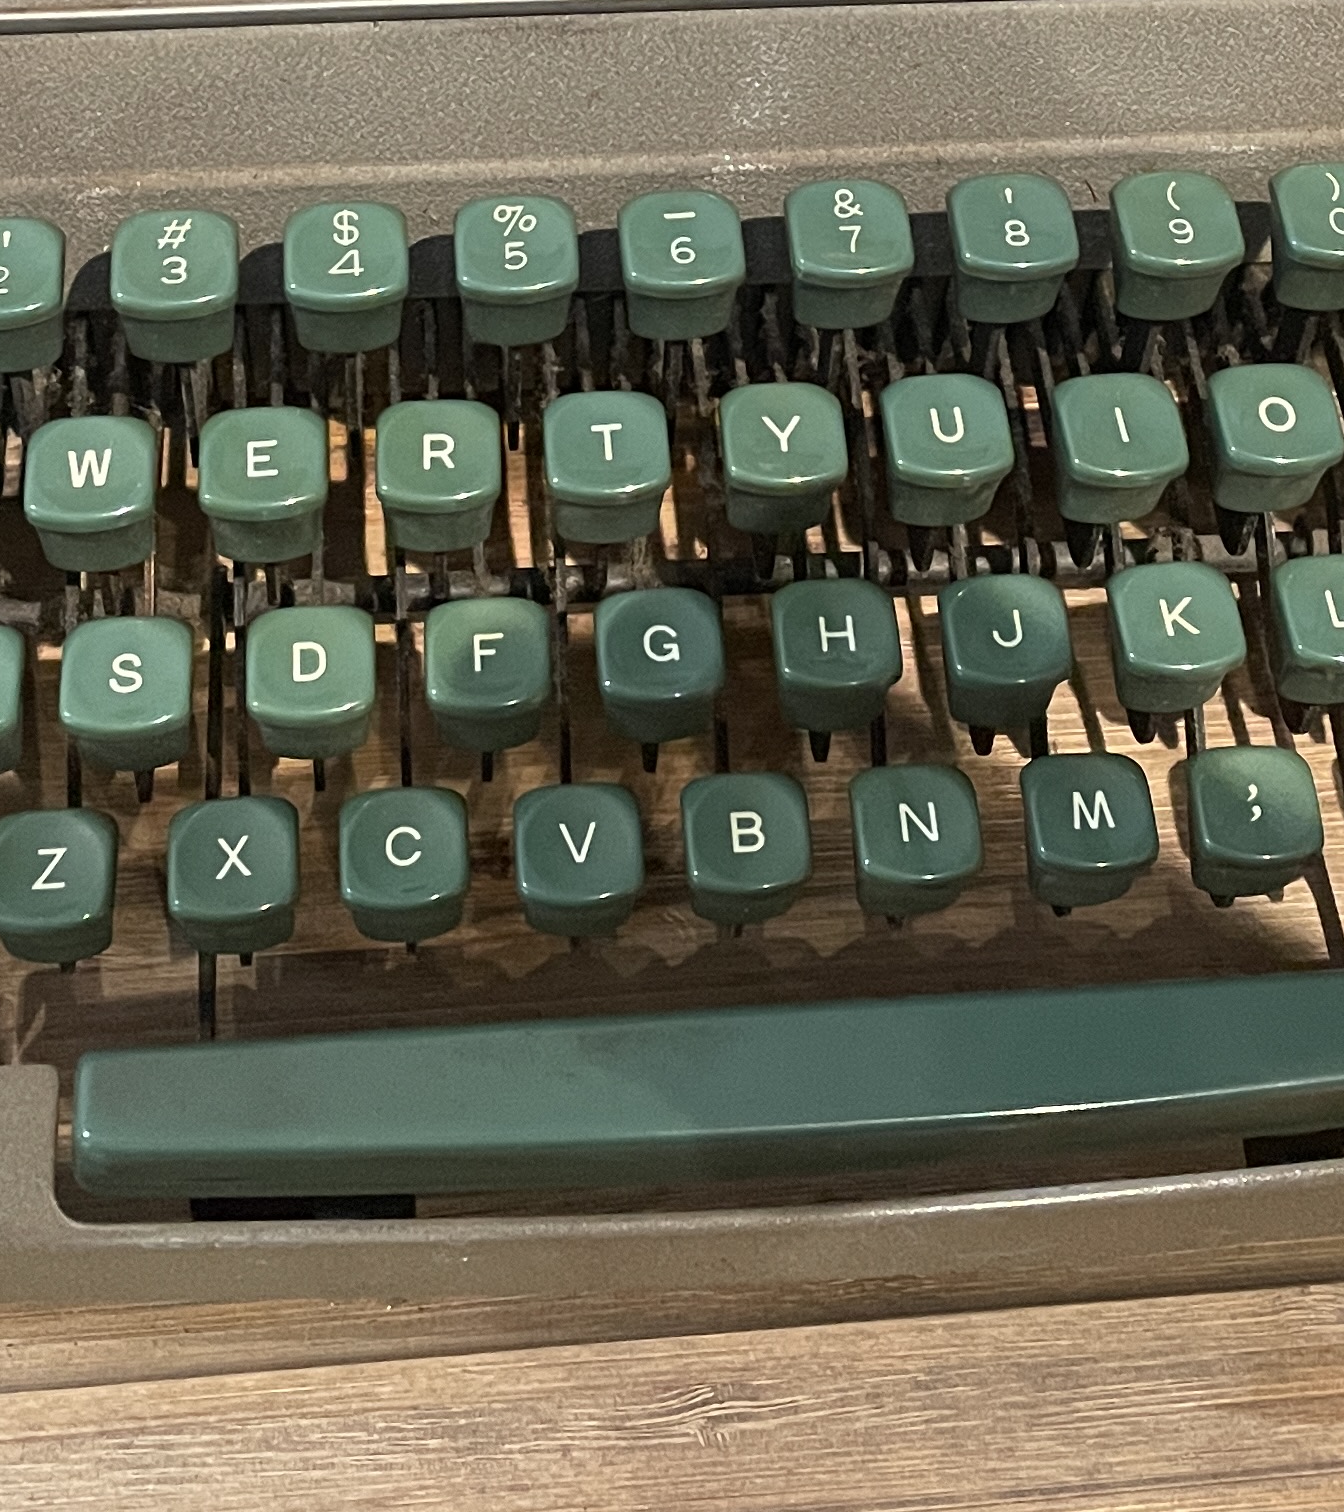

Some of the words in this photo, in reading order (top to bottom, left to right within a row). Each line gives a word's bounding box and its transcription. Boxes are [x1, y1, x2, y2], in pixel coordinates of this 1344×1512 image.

[492, 204, 537, 237] %
[833, 188, 864, 220] &
[157, 218, 193, 250] #
[332, 208, 360, 246] $
[837, 225, 862, 254] 7
[1004, 219, 1030, 248] 8
[1168, 218, 1195, 244] 9
[159, 257, 188, 285] 3
[327, 248, 365, 277] 4
[503, 241, 529, 271] 5
[669, 236, 697, 266] 6
[590, 421, 623, 462] T
[761, 414, 801, 454] Y
[929, 405, 965, 444] U
[66, 448, 113, 489] W
[246, 438, 279, 479] E
[421, 432, 456, 471] R
[817, 613, 857, 653] H
[991, 607, 1024, 649] J
[1158, 594, 1202, 639] K
[290, 640, 328, 683] D
[472, 631, 505, 673] F
[641, 623, 682, 664] G
[108, 651, 144, 694] S
[898, 799, 940, 844] N
[1070, 788, 1116, 831] M
[384, 824, 422, 867] C
[558, 820, 597, 865] V
[729, 809, 766, 854] B
[30, 846, 68, 891] Z
[214, 833, 252, 881] X
